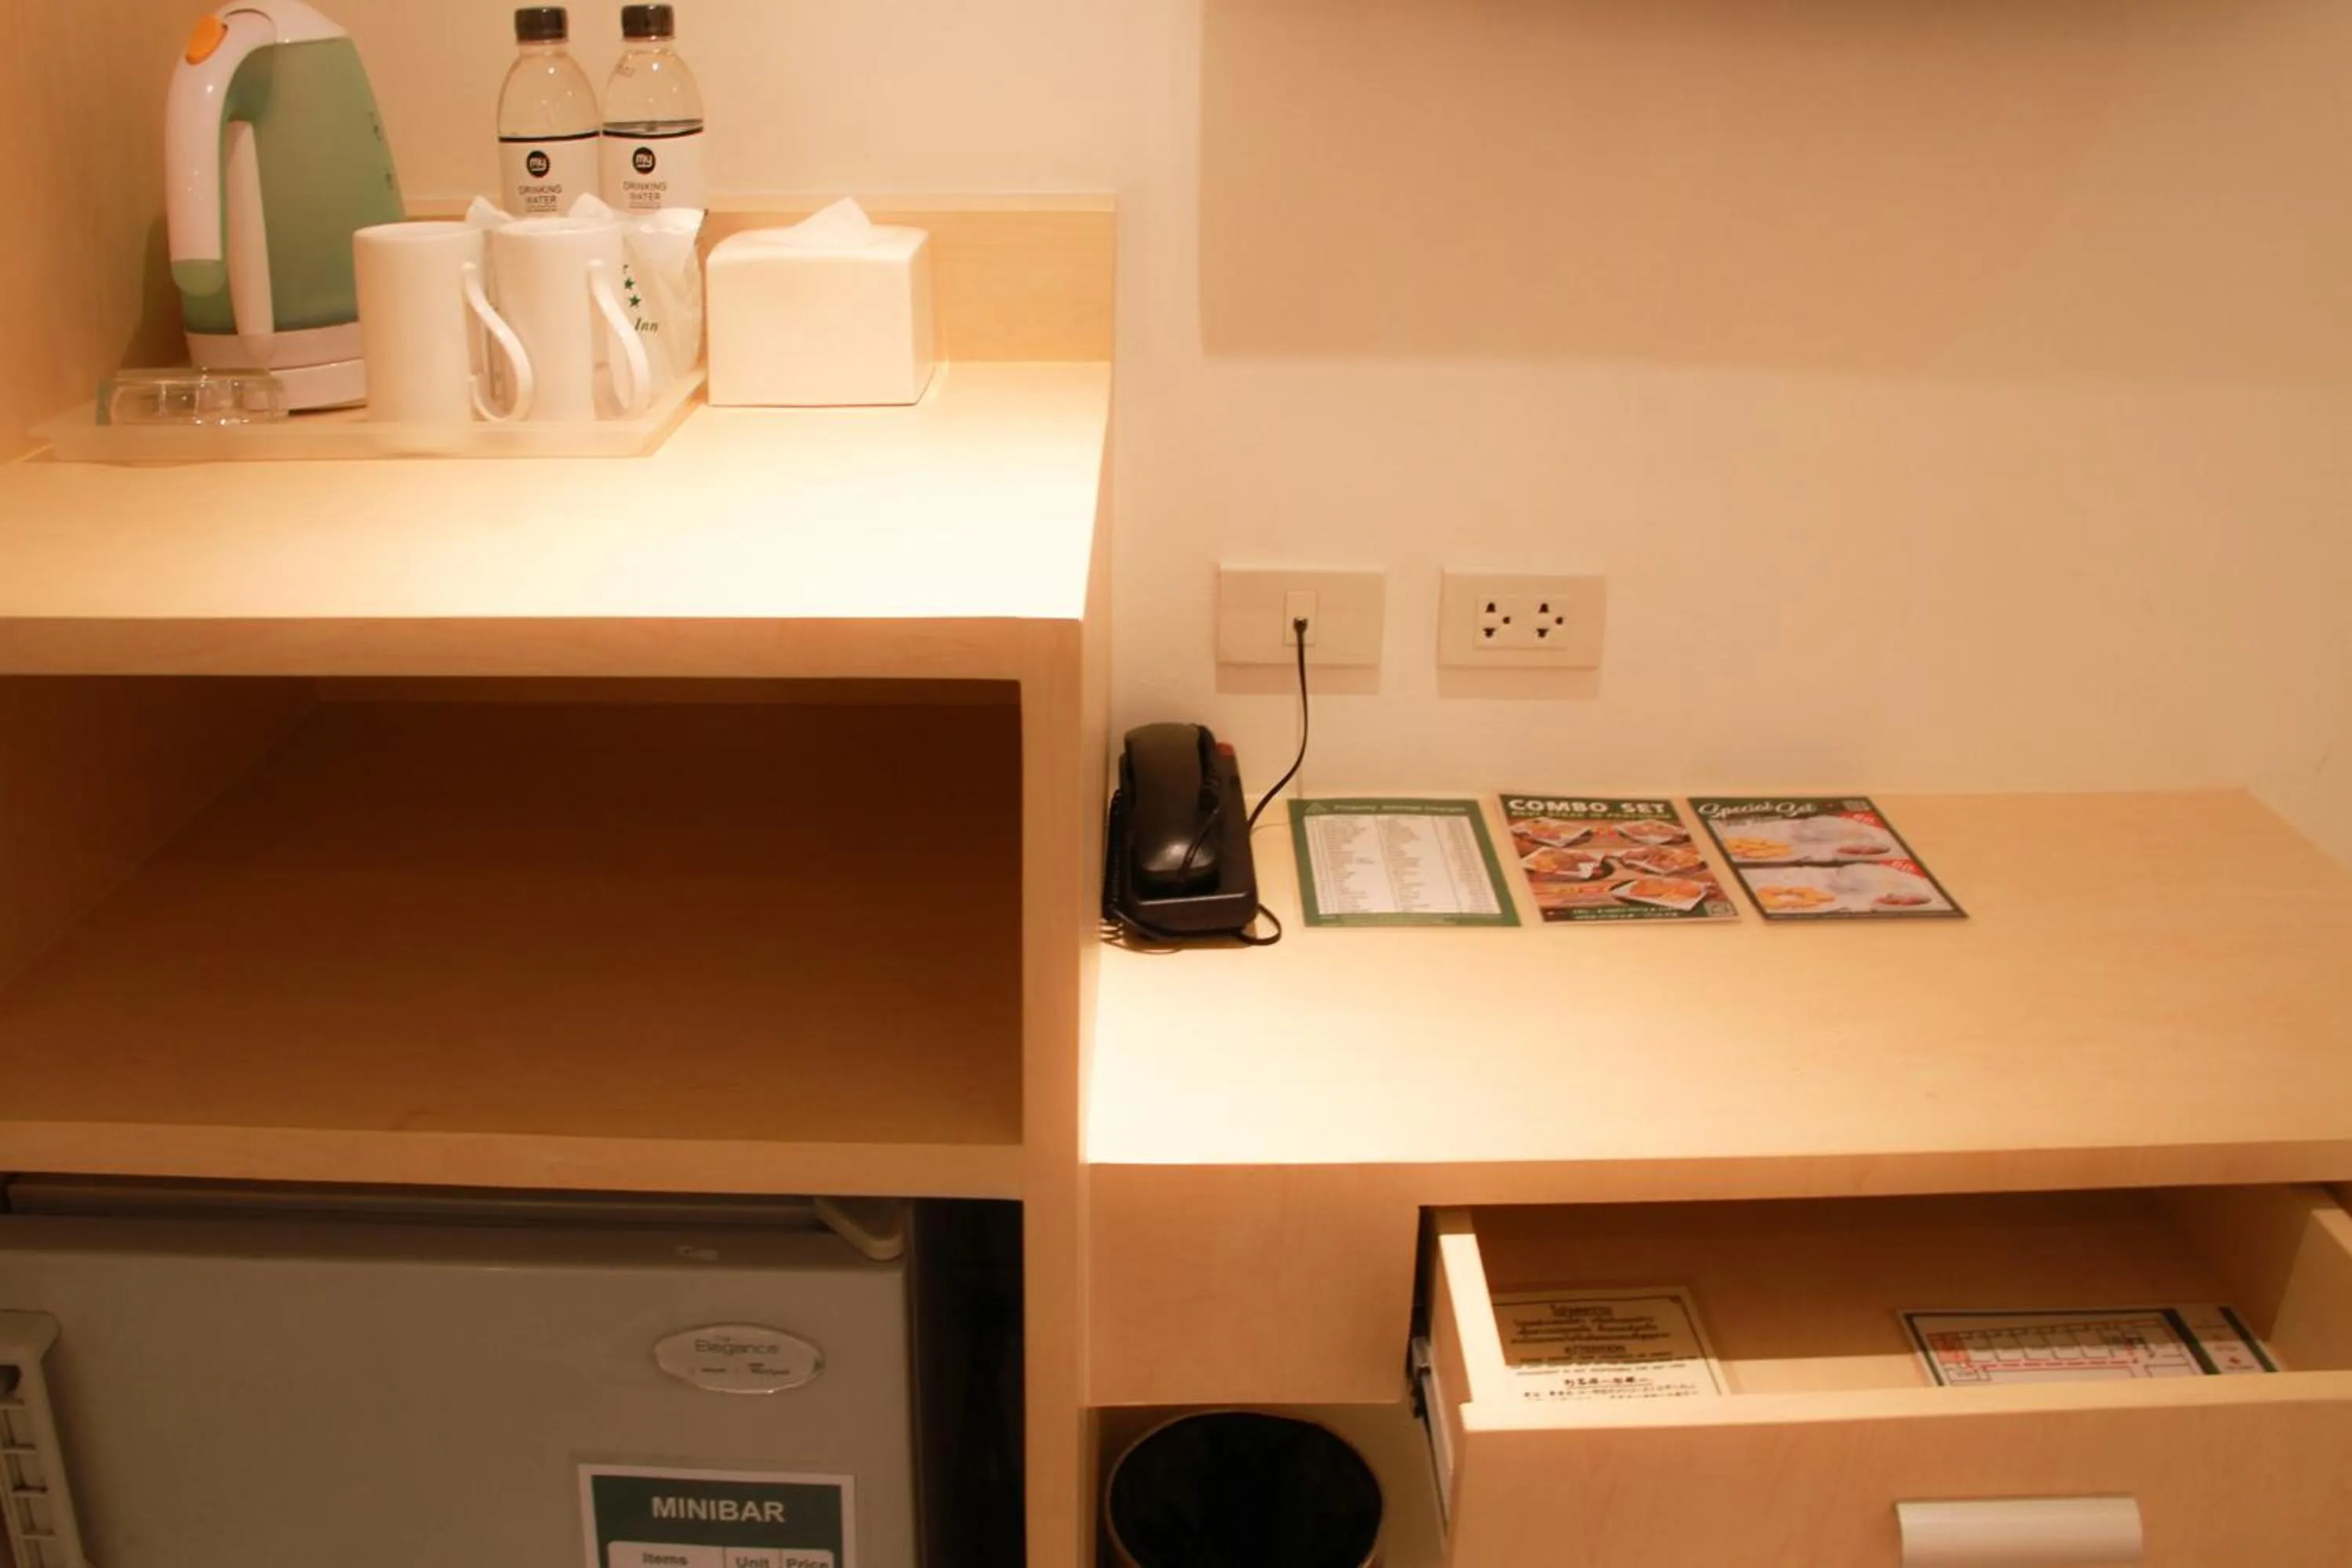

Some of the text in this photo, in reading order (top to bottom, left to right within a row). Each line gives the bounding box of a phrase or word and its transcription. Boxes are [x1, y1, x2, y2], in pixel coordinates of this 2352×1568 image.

[518, 184, 562, 195] DRINKING
[622, 181, 667, 191] DRINKING
[526, 195, 557, 205] WATER
[630, 192, 661, 201] WATER
[1508, 800, 1666, 814] COMBO SET
[695, 1338, 781, 1356] Elegance
[652, 1496, 787, 1523] MINIBAR
[641, 1552, 829, 1568] Items Unit Price
